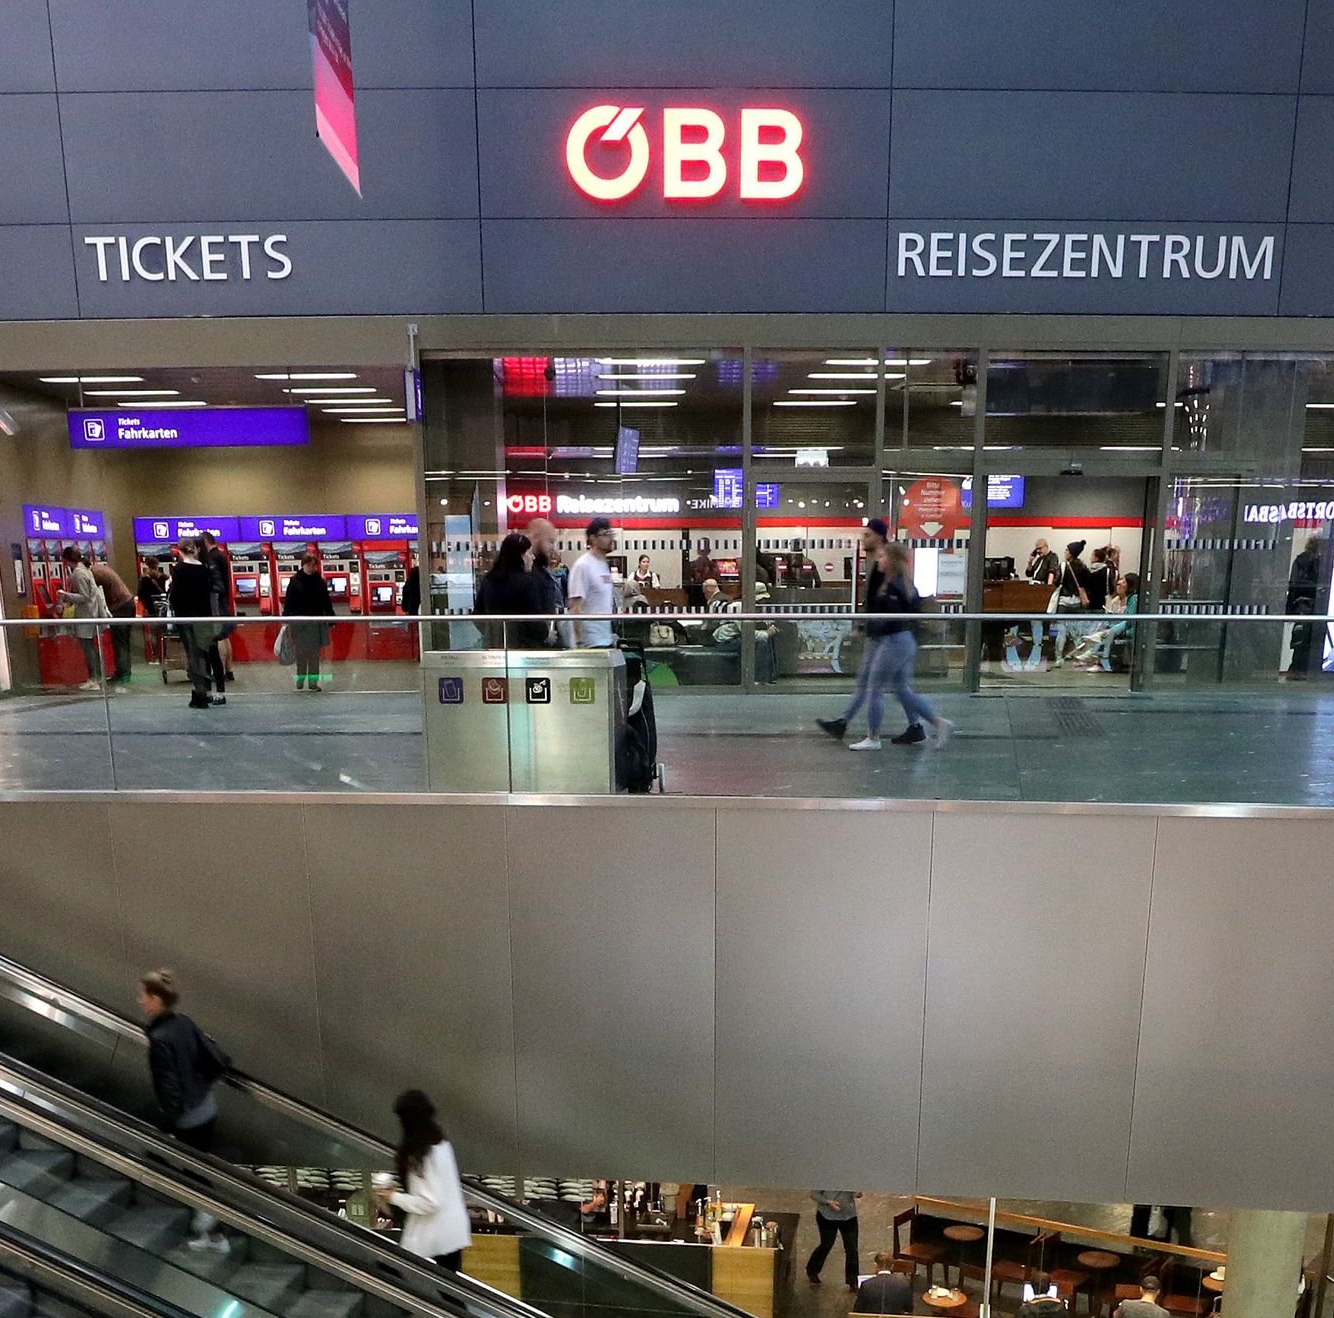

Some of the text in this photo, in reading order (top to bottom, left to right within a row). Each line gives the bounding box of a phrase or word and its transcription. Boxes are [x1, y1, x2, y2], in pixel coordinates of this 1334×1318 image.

[566, 105, 805, 200] ÖBB
[85, 235, 292, 281] TICKETS
[897, 233, 1275, 280] REISEZENTRUM
[118, 418, 141, 426] Tickets
[118, 427, 178, 440] Fahrkarten
[508, 494, 680, 513] ÖBB Reisezentrum
[283, 525, 327, 536] Fahrkarten
